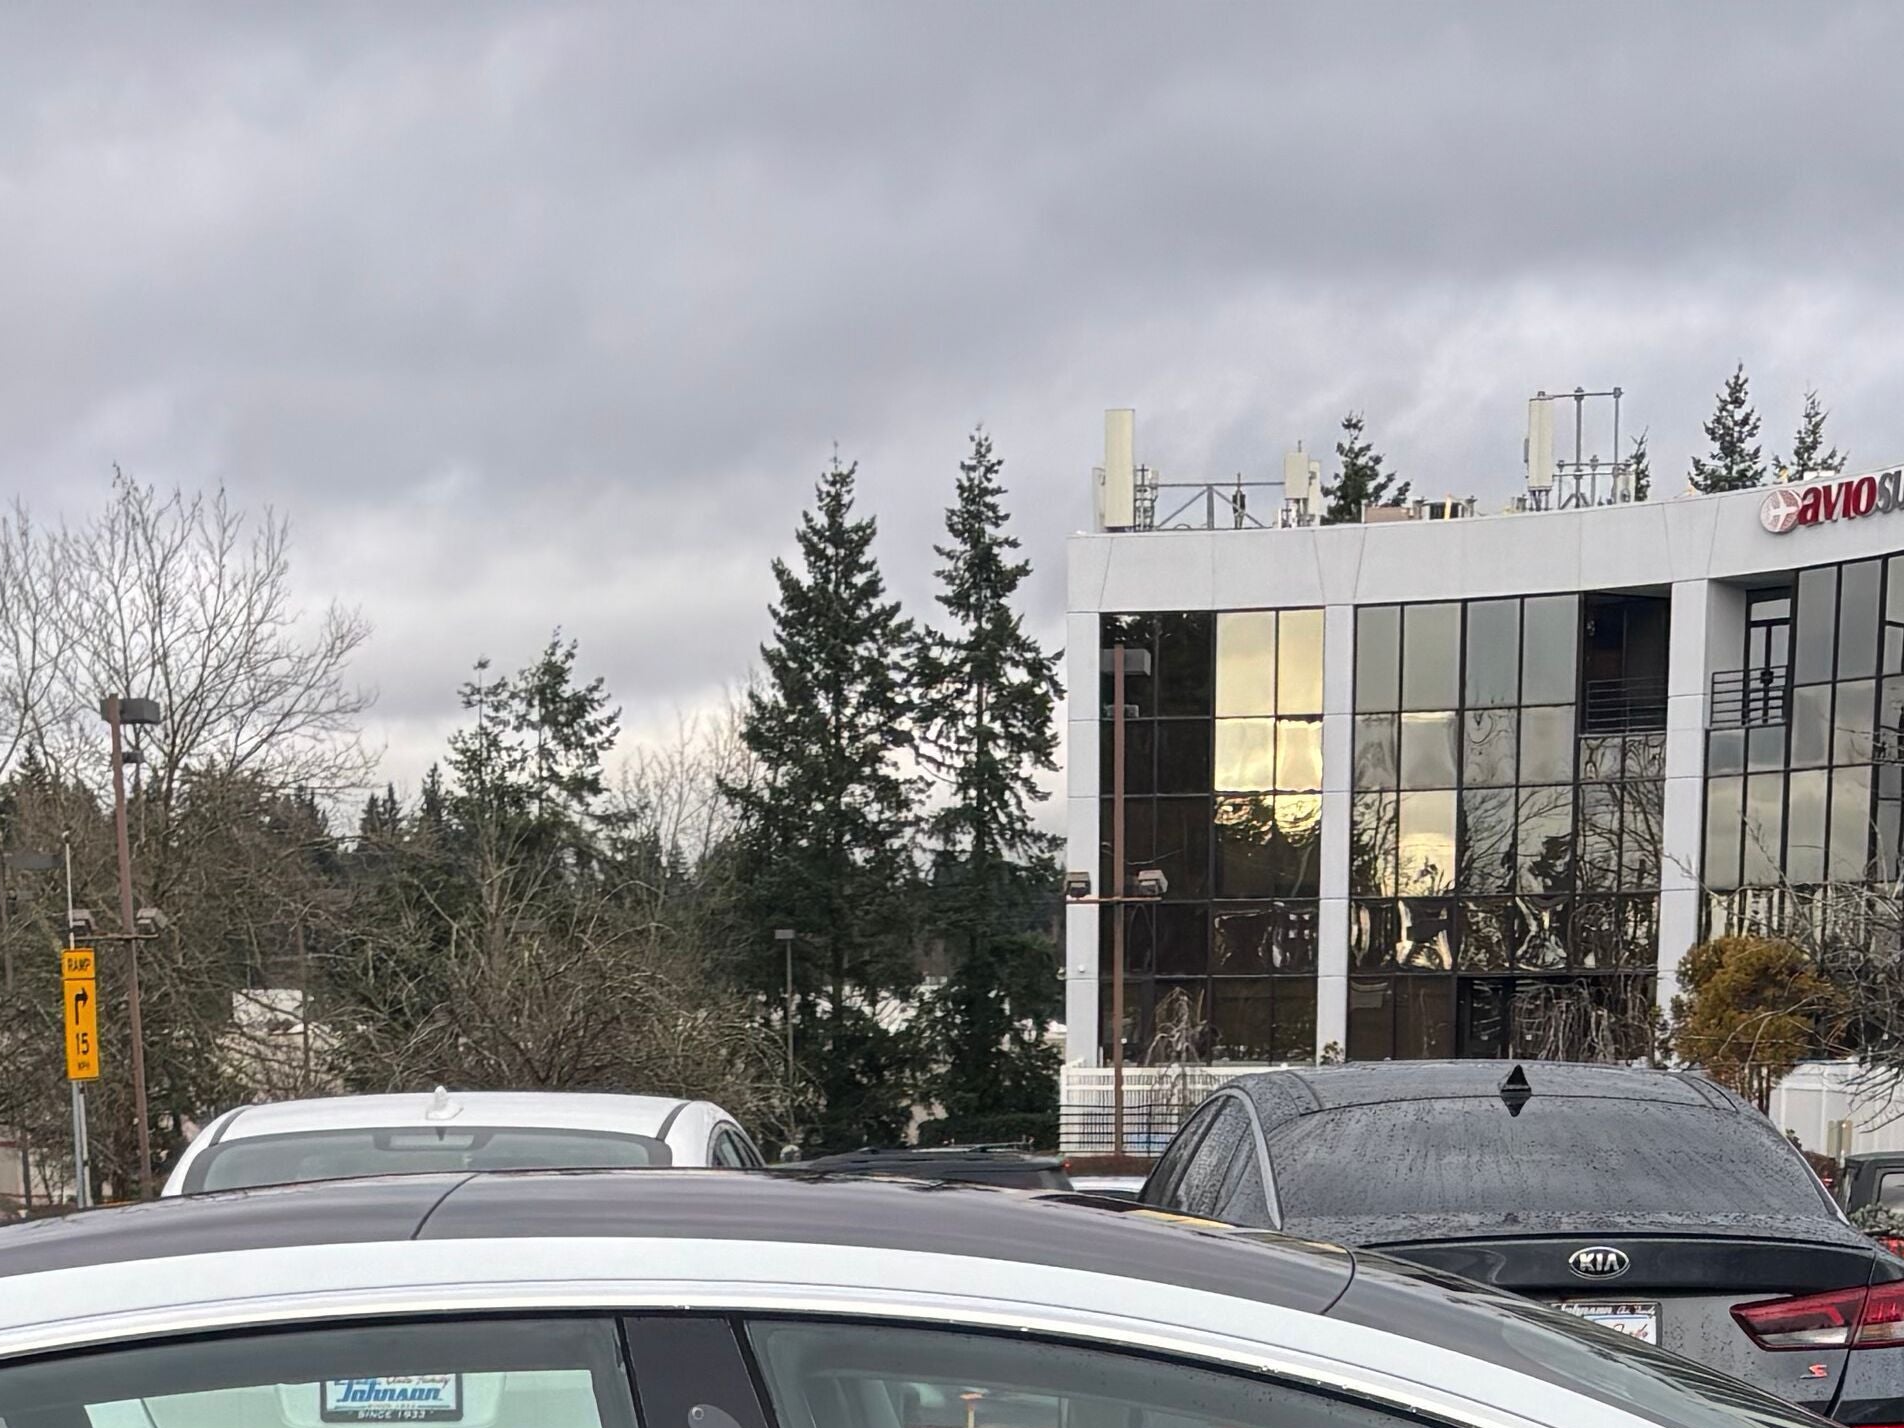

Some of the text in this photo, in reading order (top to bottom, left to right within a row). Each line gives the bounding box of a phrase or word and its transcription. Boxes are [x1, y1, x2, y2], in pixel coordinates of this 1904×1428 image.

[67, 958, 91, 972] RAMP
[76, 1032, 90, 1056] 15
[1579, 1253, 1620, 1271] KIA
[336, 1380, 443, 1402] Johnson
